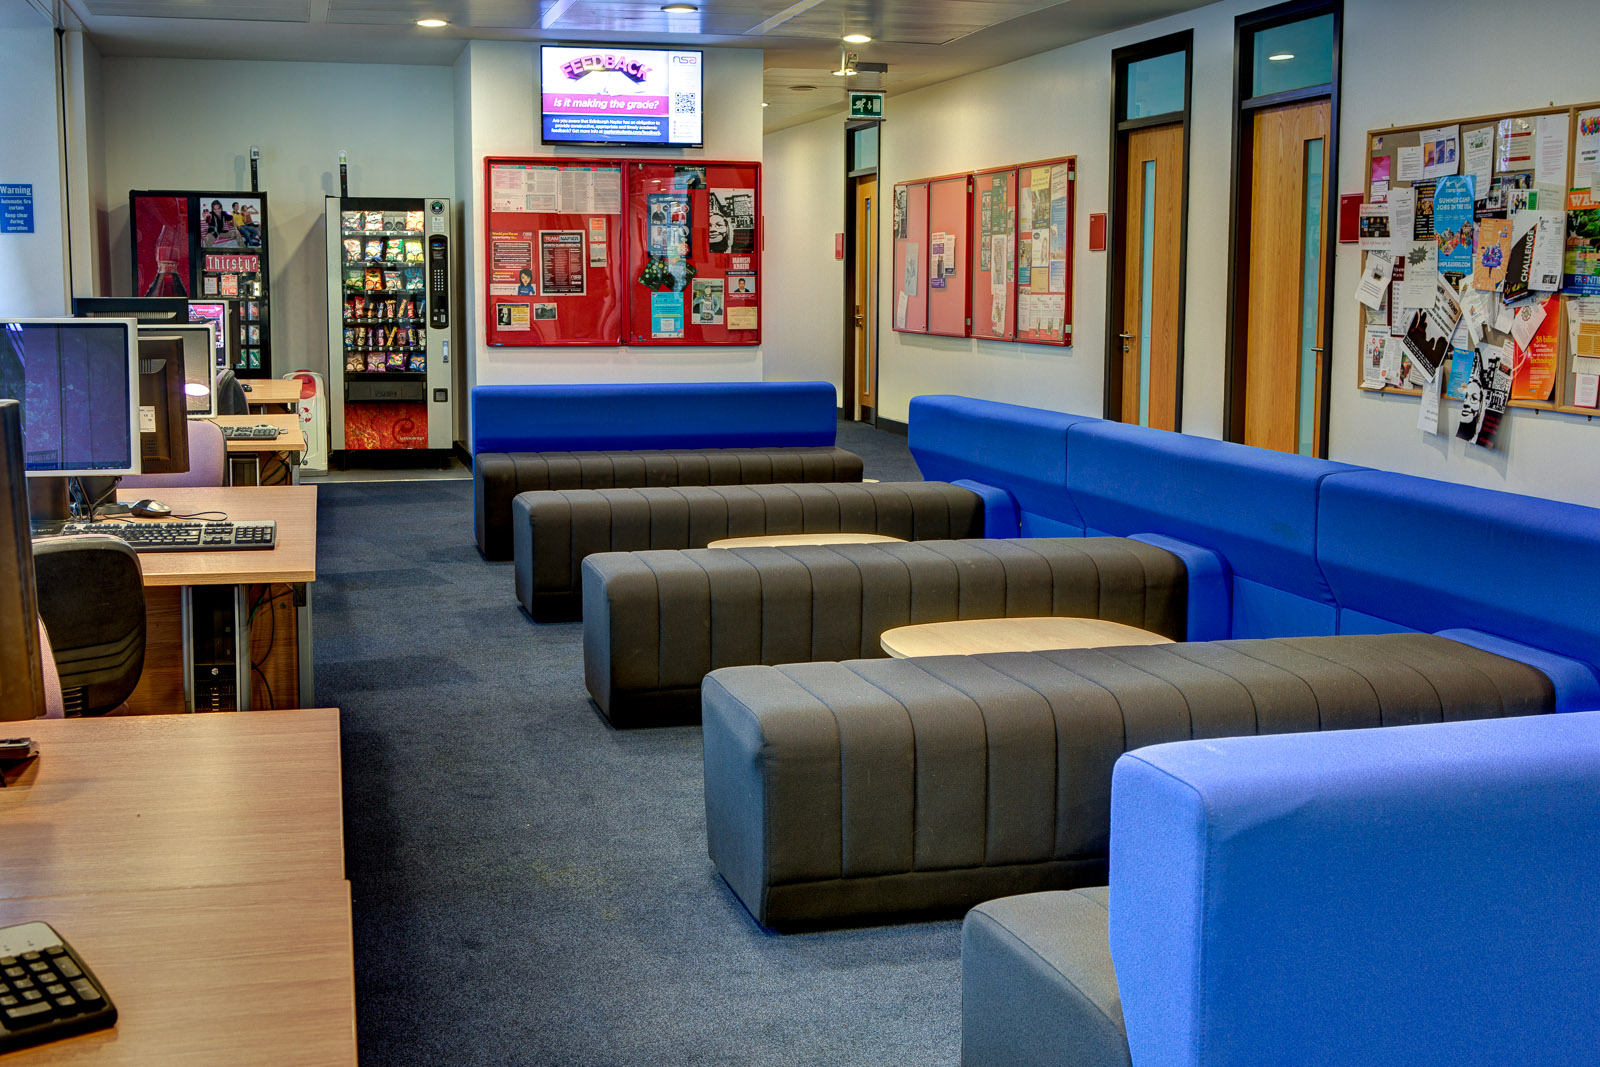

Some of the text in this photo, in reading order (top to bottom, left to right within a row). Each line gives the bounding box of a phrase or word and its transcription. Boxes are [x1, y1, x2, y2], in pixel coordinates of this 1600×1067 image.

[560, 54, 653, 81] FEEDBACK
[553, 98, 659, 110] Is it making the grade?
[0, 186, 31, 195] Warning
[1521, 229, 1535, 282] CHALLENGE
[208, 256, 257, 271] Thirsty?
[1530, 357, 1552, 365] Technology
